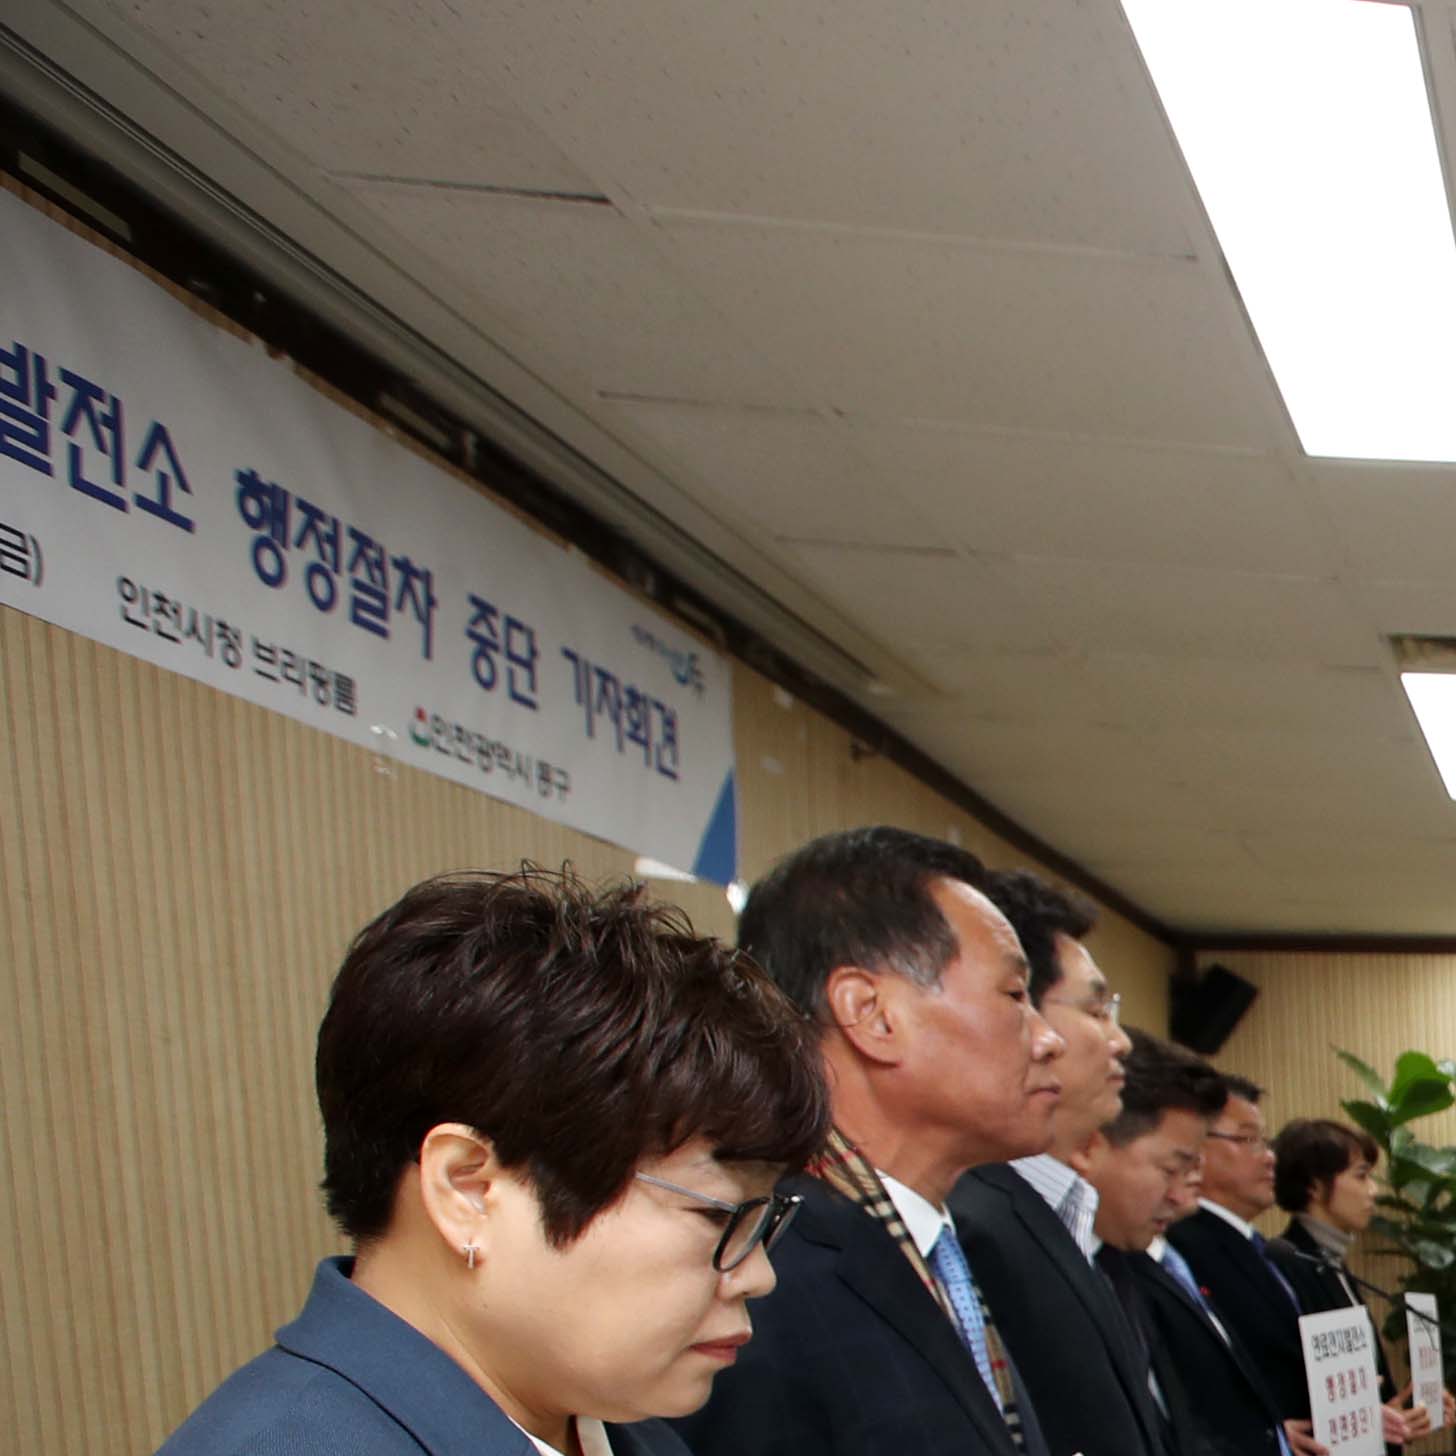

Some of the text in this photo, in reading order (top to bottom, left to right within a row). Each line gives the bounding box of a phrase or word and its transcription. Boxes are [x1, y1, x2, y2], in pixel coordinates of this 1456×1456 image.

[0, 340, 196, 534] 발전소
[234, 467, 439, 662] 행정절차
[465, 592, 540, 712] 중단
[560, 645, 681, 782] 기자회견
[117, 574, 244, 670] 인천시청
[251, 635, 358, 718] 브리핑룸
[431, 713, 574, 803] 인천광역시 동구
